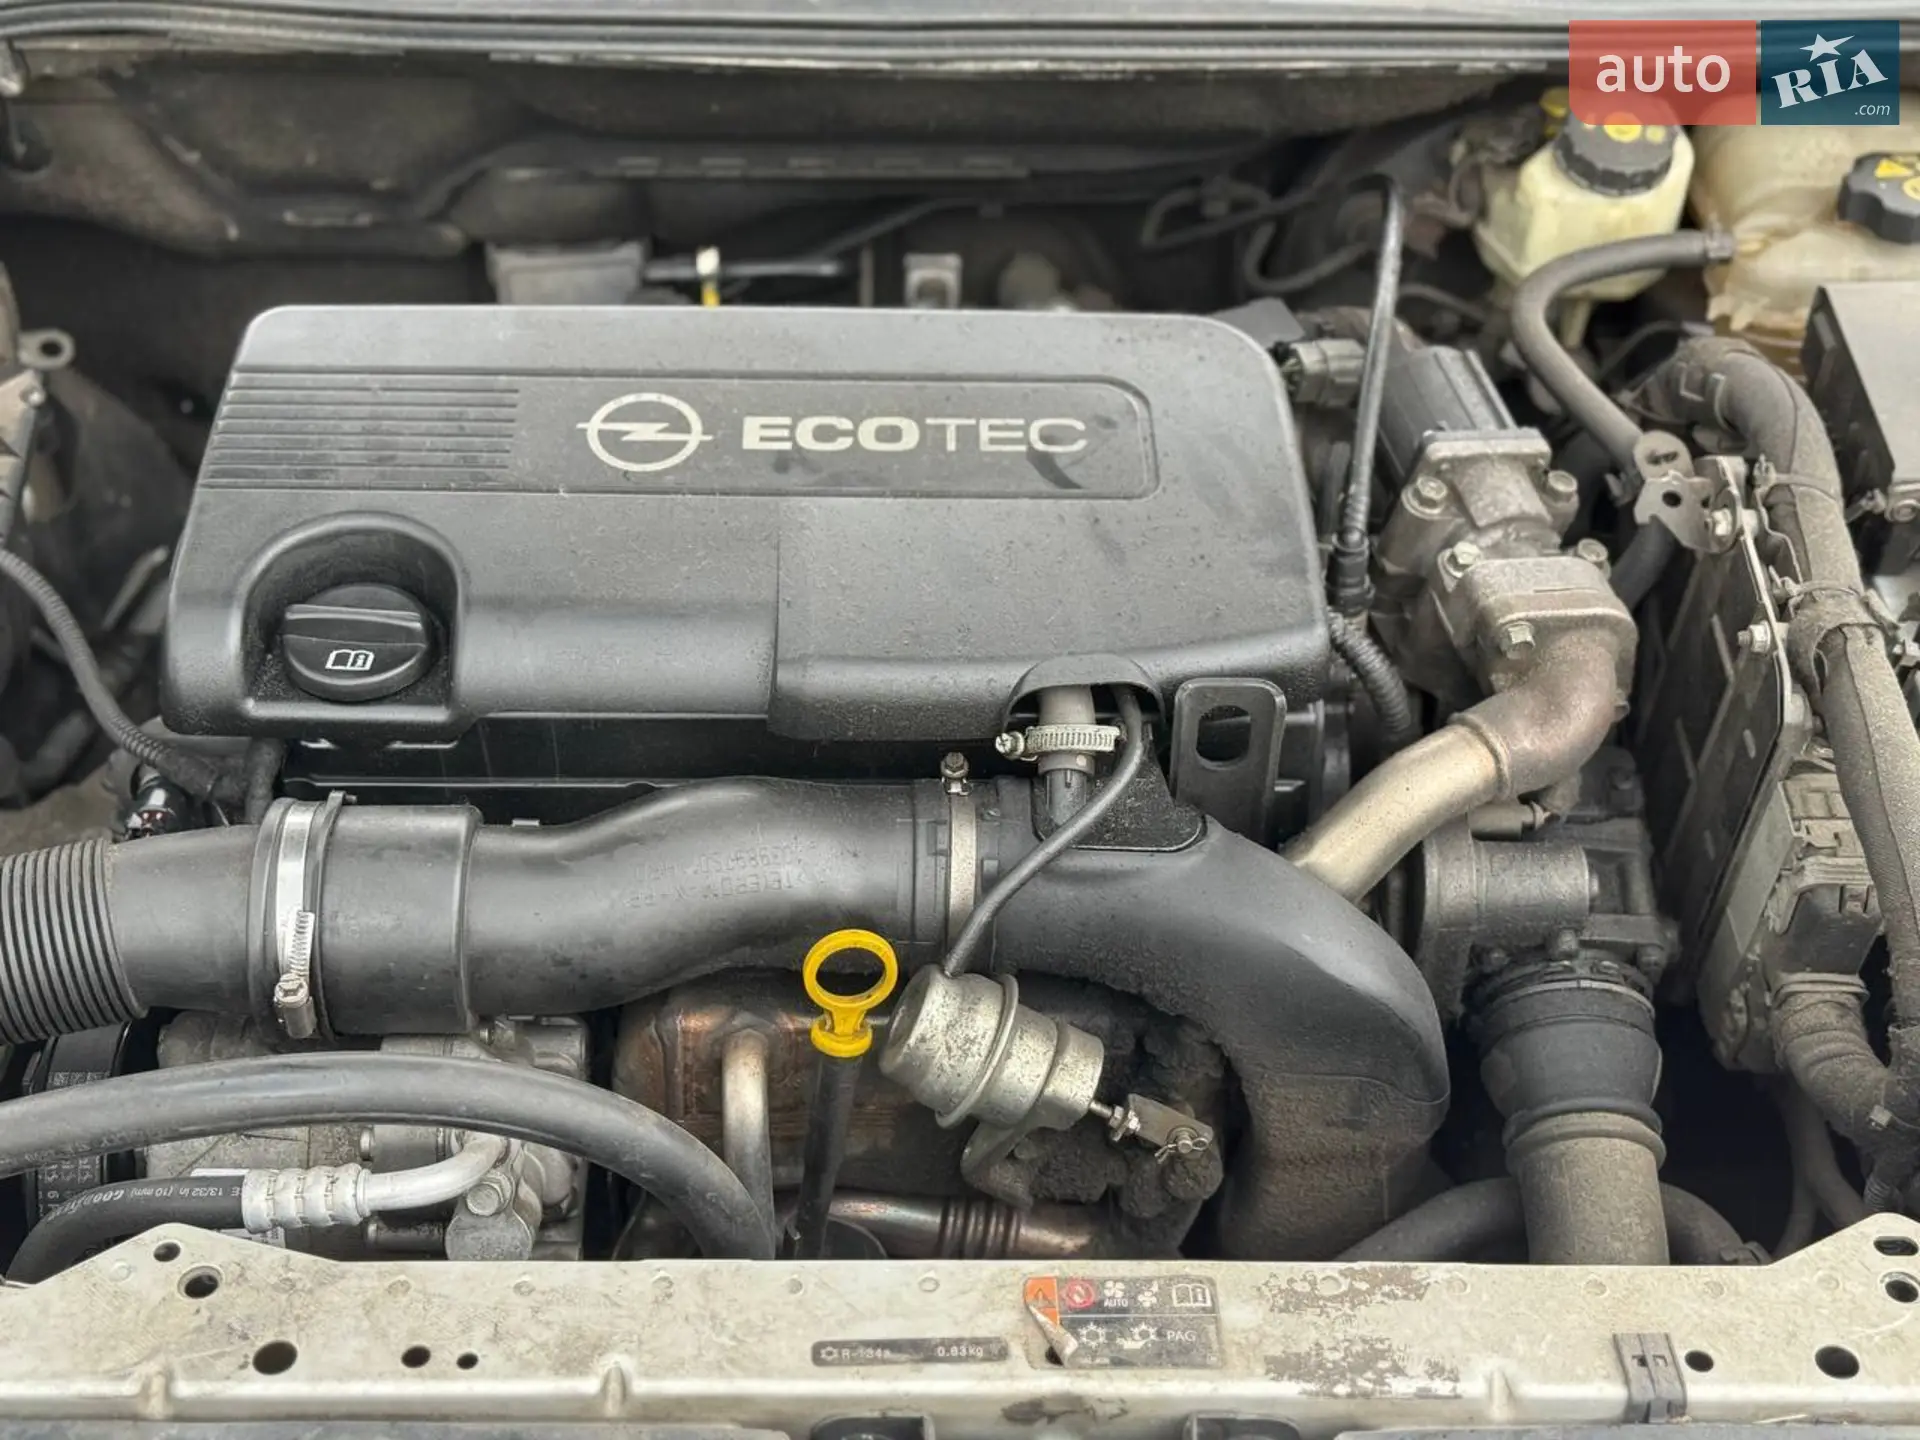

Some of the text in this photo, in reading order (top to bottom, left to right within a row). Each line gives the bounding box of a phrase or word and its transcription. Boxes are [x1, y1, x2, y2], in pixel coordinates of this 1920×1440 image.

[742, 415, 1088, 453] ECOTEC
[1103, 1298, 1129, 1308] AUTO
[1166, 1330, 1198, 1343] PAG
